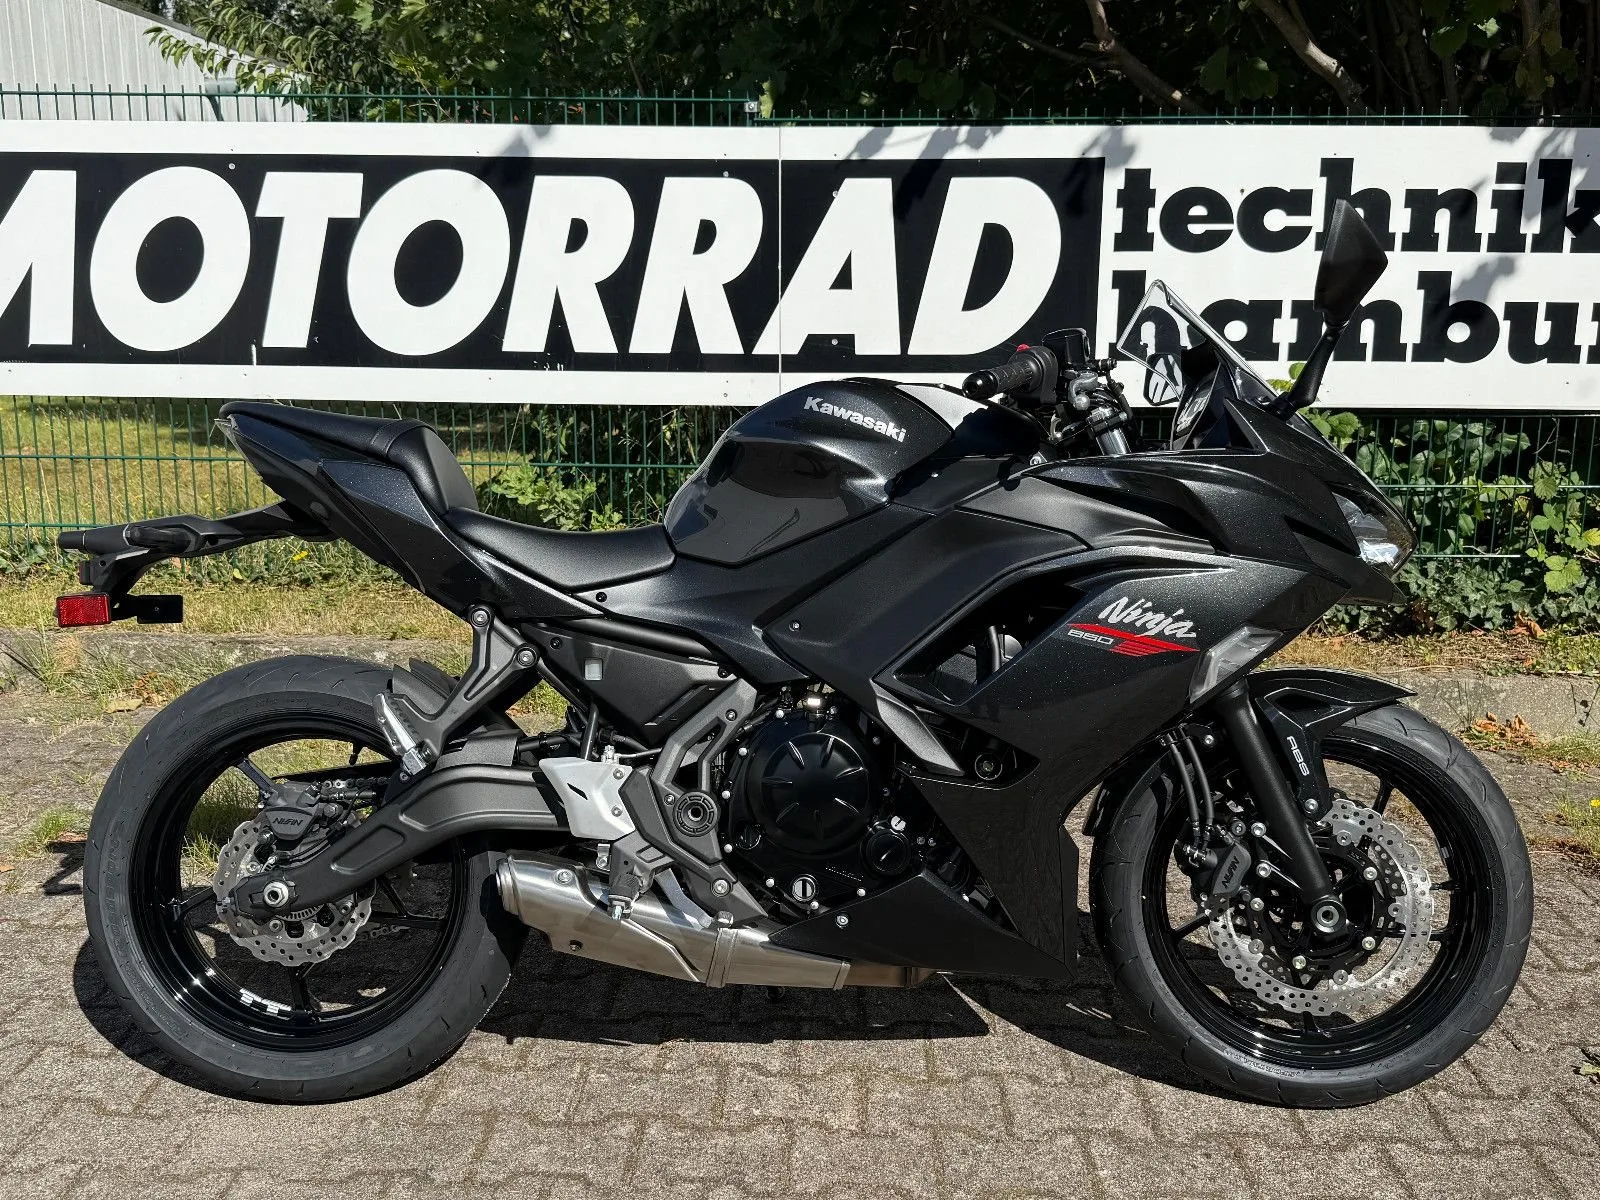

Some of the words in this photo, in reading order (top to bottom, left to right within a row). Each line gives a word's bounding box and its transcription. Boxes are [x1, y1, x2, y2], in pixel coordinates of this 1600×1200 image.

[1113, 157, 1600, 253] technik
[1108, 269, 1600, 365] hambu
[803, 396, 907, 443] Kawasaki
[1097, 596, 1197, 638] Ninja
[1286, 735, 1310, 776] ABS
